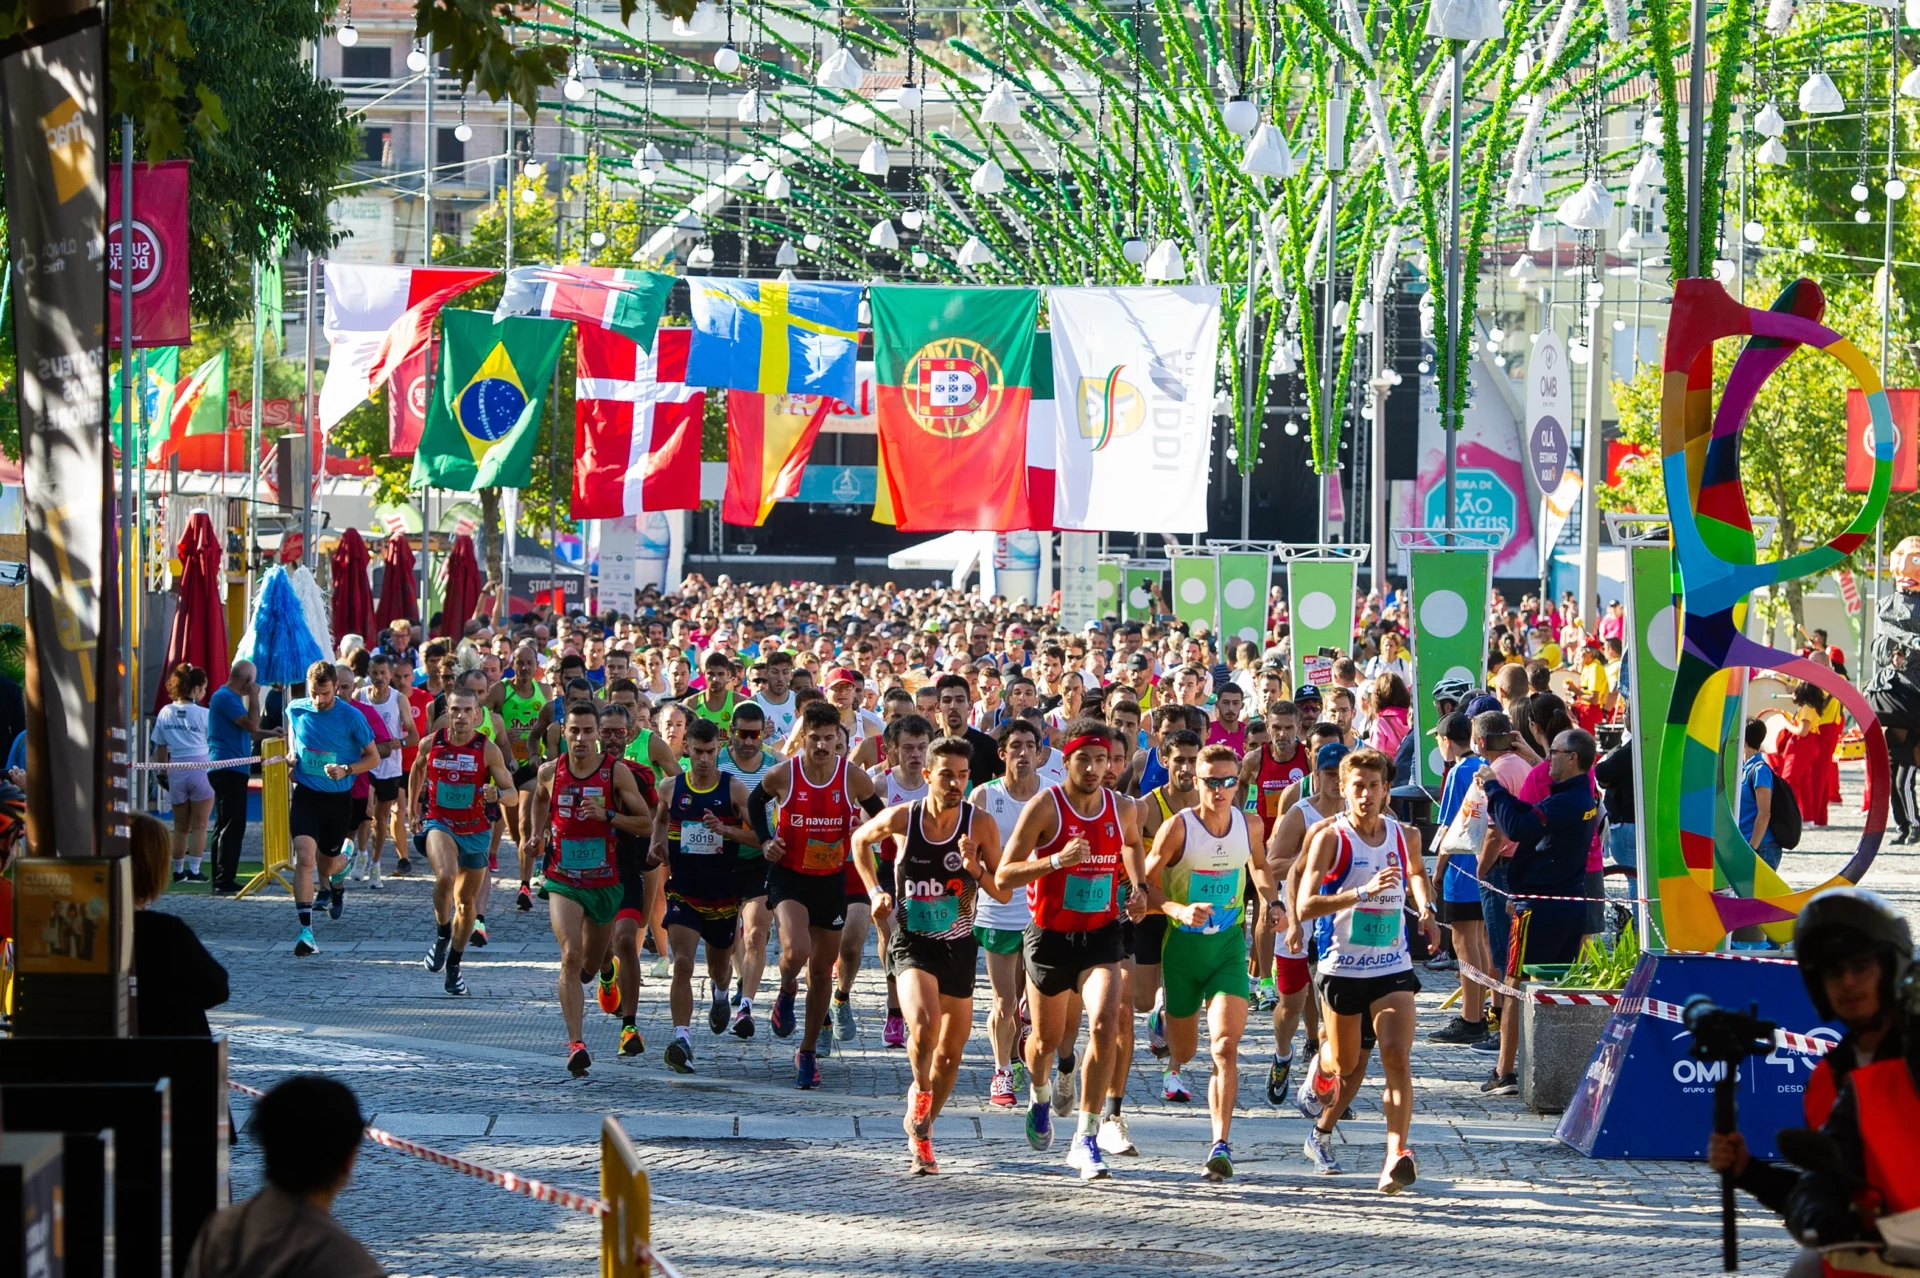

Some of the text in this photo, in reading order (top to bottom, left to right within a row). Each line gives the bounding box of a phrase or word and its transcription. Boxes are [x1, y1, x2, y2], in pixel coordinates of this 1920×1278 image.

[1455, 480, 1478, 490] EIRA
[564, 580, 578, 594] GO
[307, 759, 328, 768] 410
[805, 815, 843, 826] navarra
[689, 833, 714, 843] 3019
[570, 849, 596, 859] 1297
[1076, 888, 1104, 899] 4110
[1201, 883, 1230, 894] 4109
[918, 908, 948, 920] 4116
[1364, 922, 1391, 935] 4101
[1777, 1085, 1807, 1093] DESD
